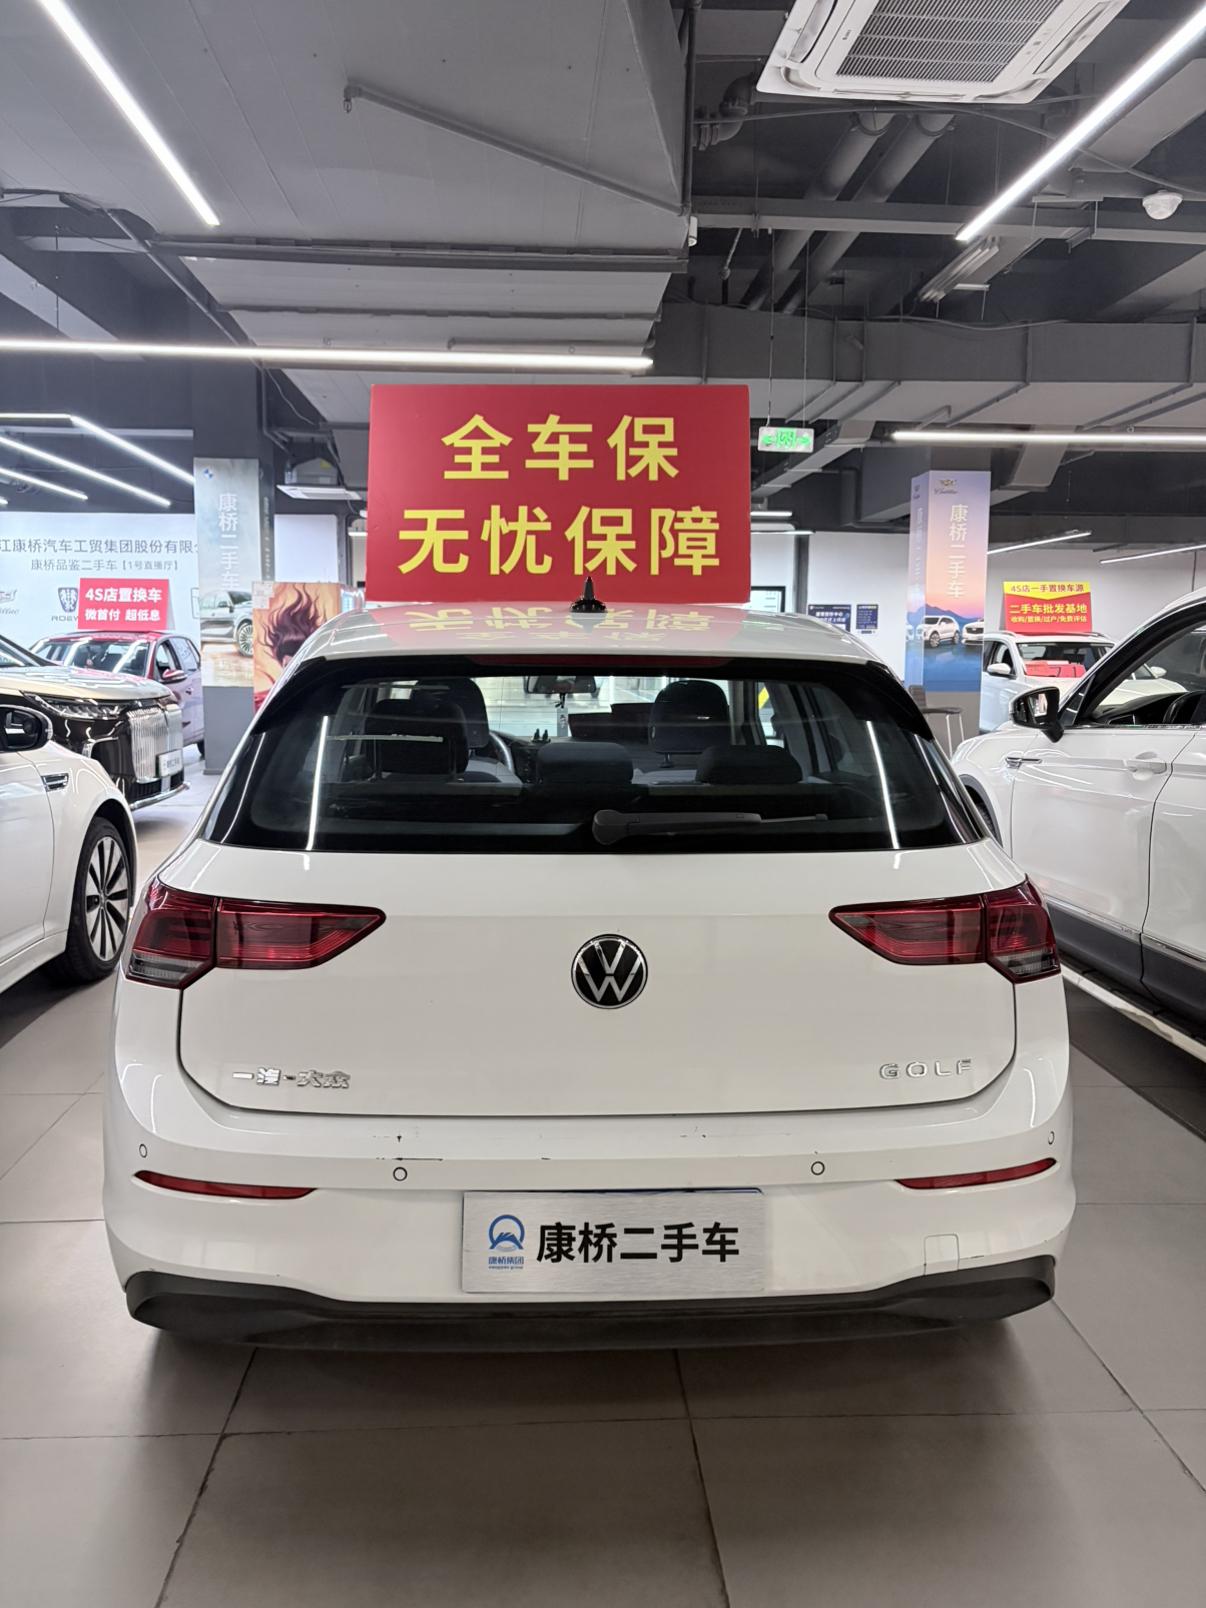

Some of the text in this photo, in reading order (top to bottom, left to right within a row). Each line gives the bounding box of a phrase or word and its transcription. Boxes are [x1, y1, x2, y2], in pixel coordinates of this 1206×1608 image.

[441, 414, 679, 481] 全车保
[219, 493, 239, 588] 康桥二手车
[398, 505, 721, 576] 无忧保障
[947, 504, 969, 598] 康桥二手车
[85, 587, 162, 603] 4S店置换车
[1009, 603, 1087, 614] 二手车批发基地
[125, 609, 160, 621] 超低息
[232, 1067, 351, 1089] 一汽-大众
[879, 1058, 971, 1080] GOLF
[536, 1222, 739, 1264] 康桥二手车
